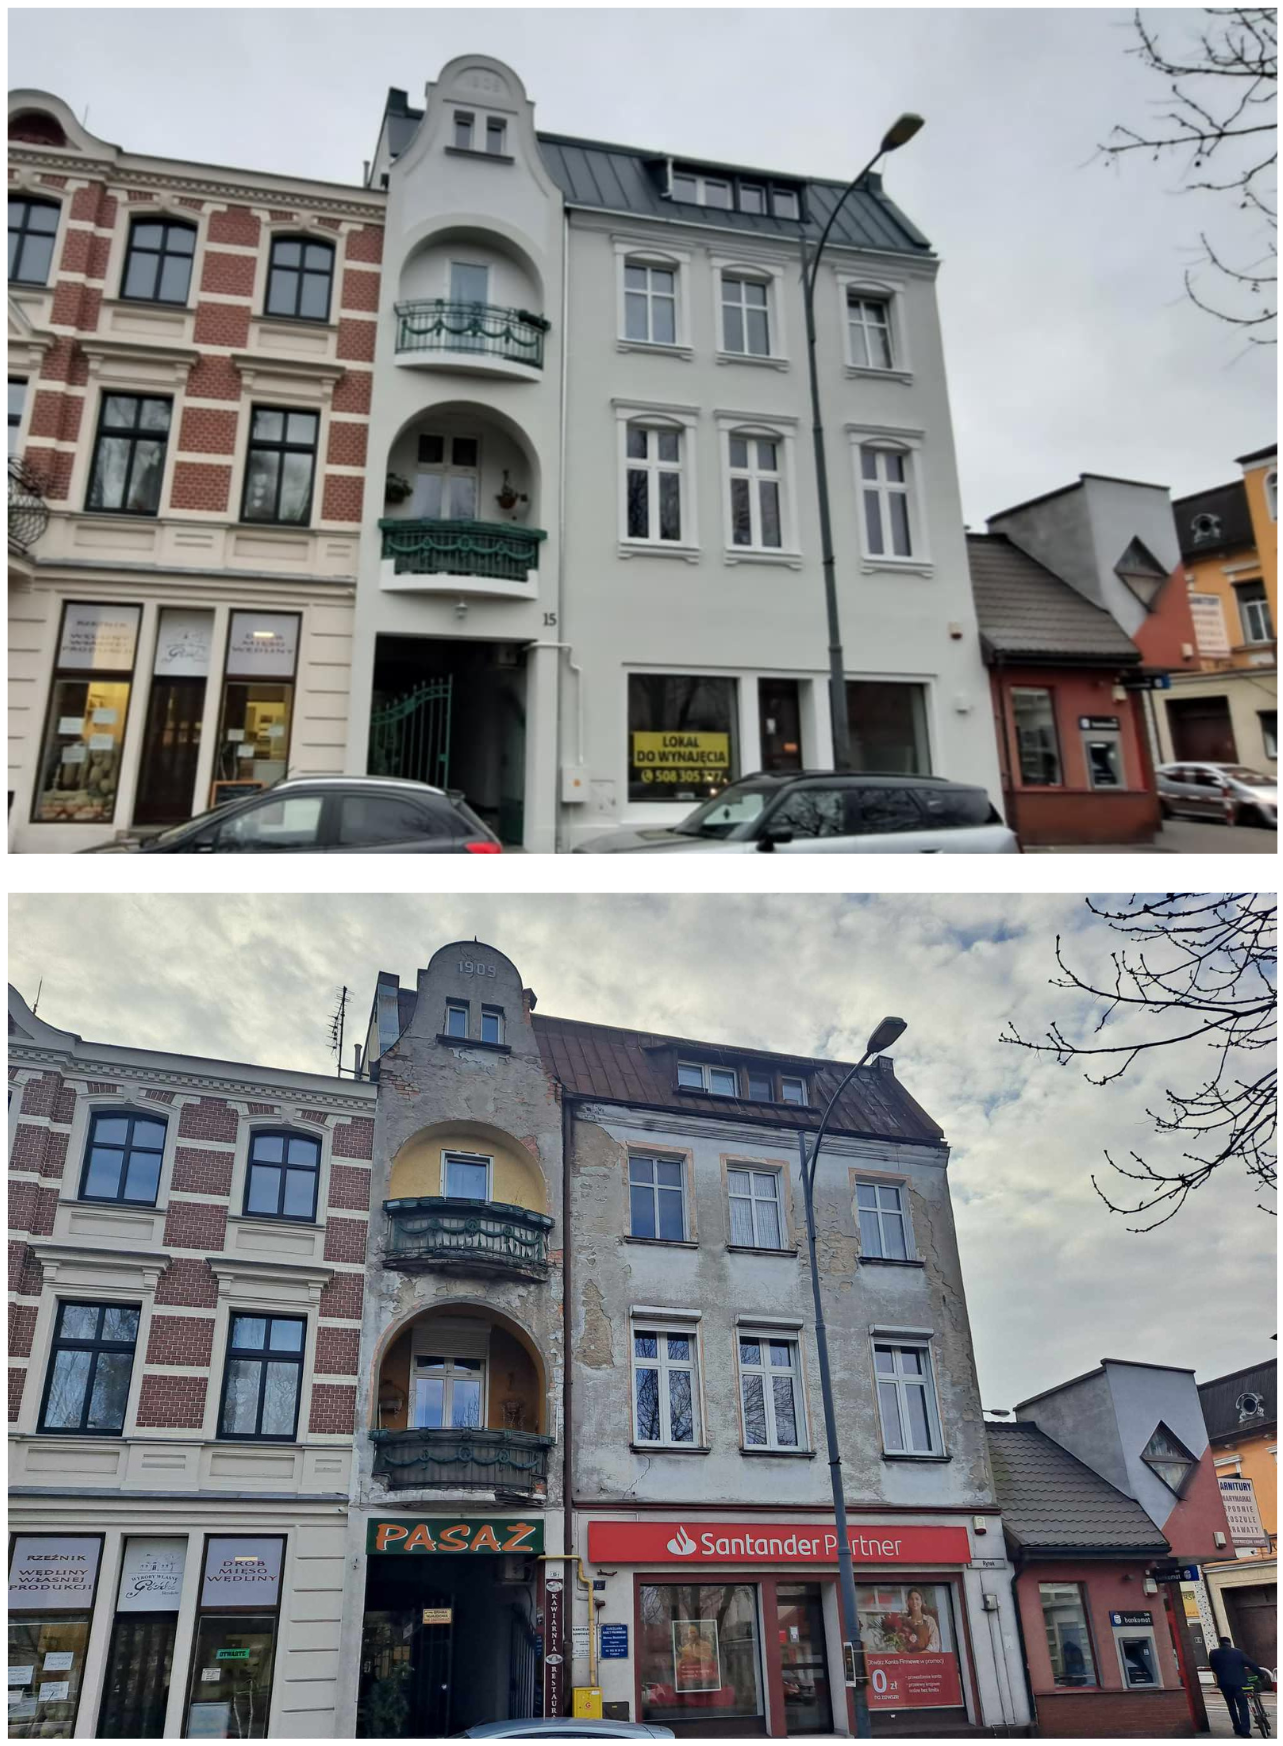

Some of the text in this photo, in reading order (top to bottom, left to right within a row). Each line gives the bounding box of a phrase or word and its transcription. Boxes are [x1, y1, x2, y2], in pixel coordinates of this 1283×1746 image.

[543, 612, 557, 626] 15
[662, 735, 700, 748] LOKAL
[637, 750, 725, 766] DO WYNAJĘCIA
[655, 769, 678, 782] 508
[680, 769, 700, 782] 305
[459, 960, 496, 978] 1909
[1220, 1482, 1251, 1492] ARNITURY
[376, 1522, 537, 1551] PASAŻ
[701, 1532, 902, 1556] Santander Prtner
[19, 1569, 88, 1577] WĘDLINY
[550, 1593, 558, 1652] KAWIARNIA
[872, 1669, 898, 1694] 0 zł
